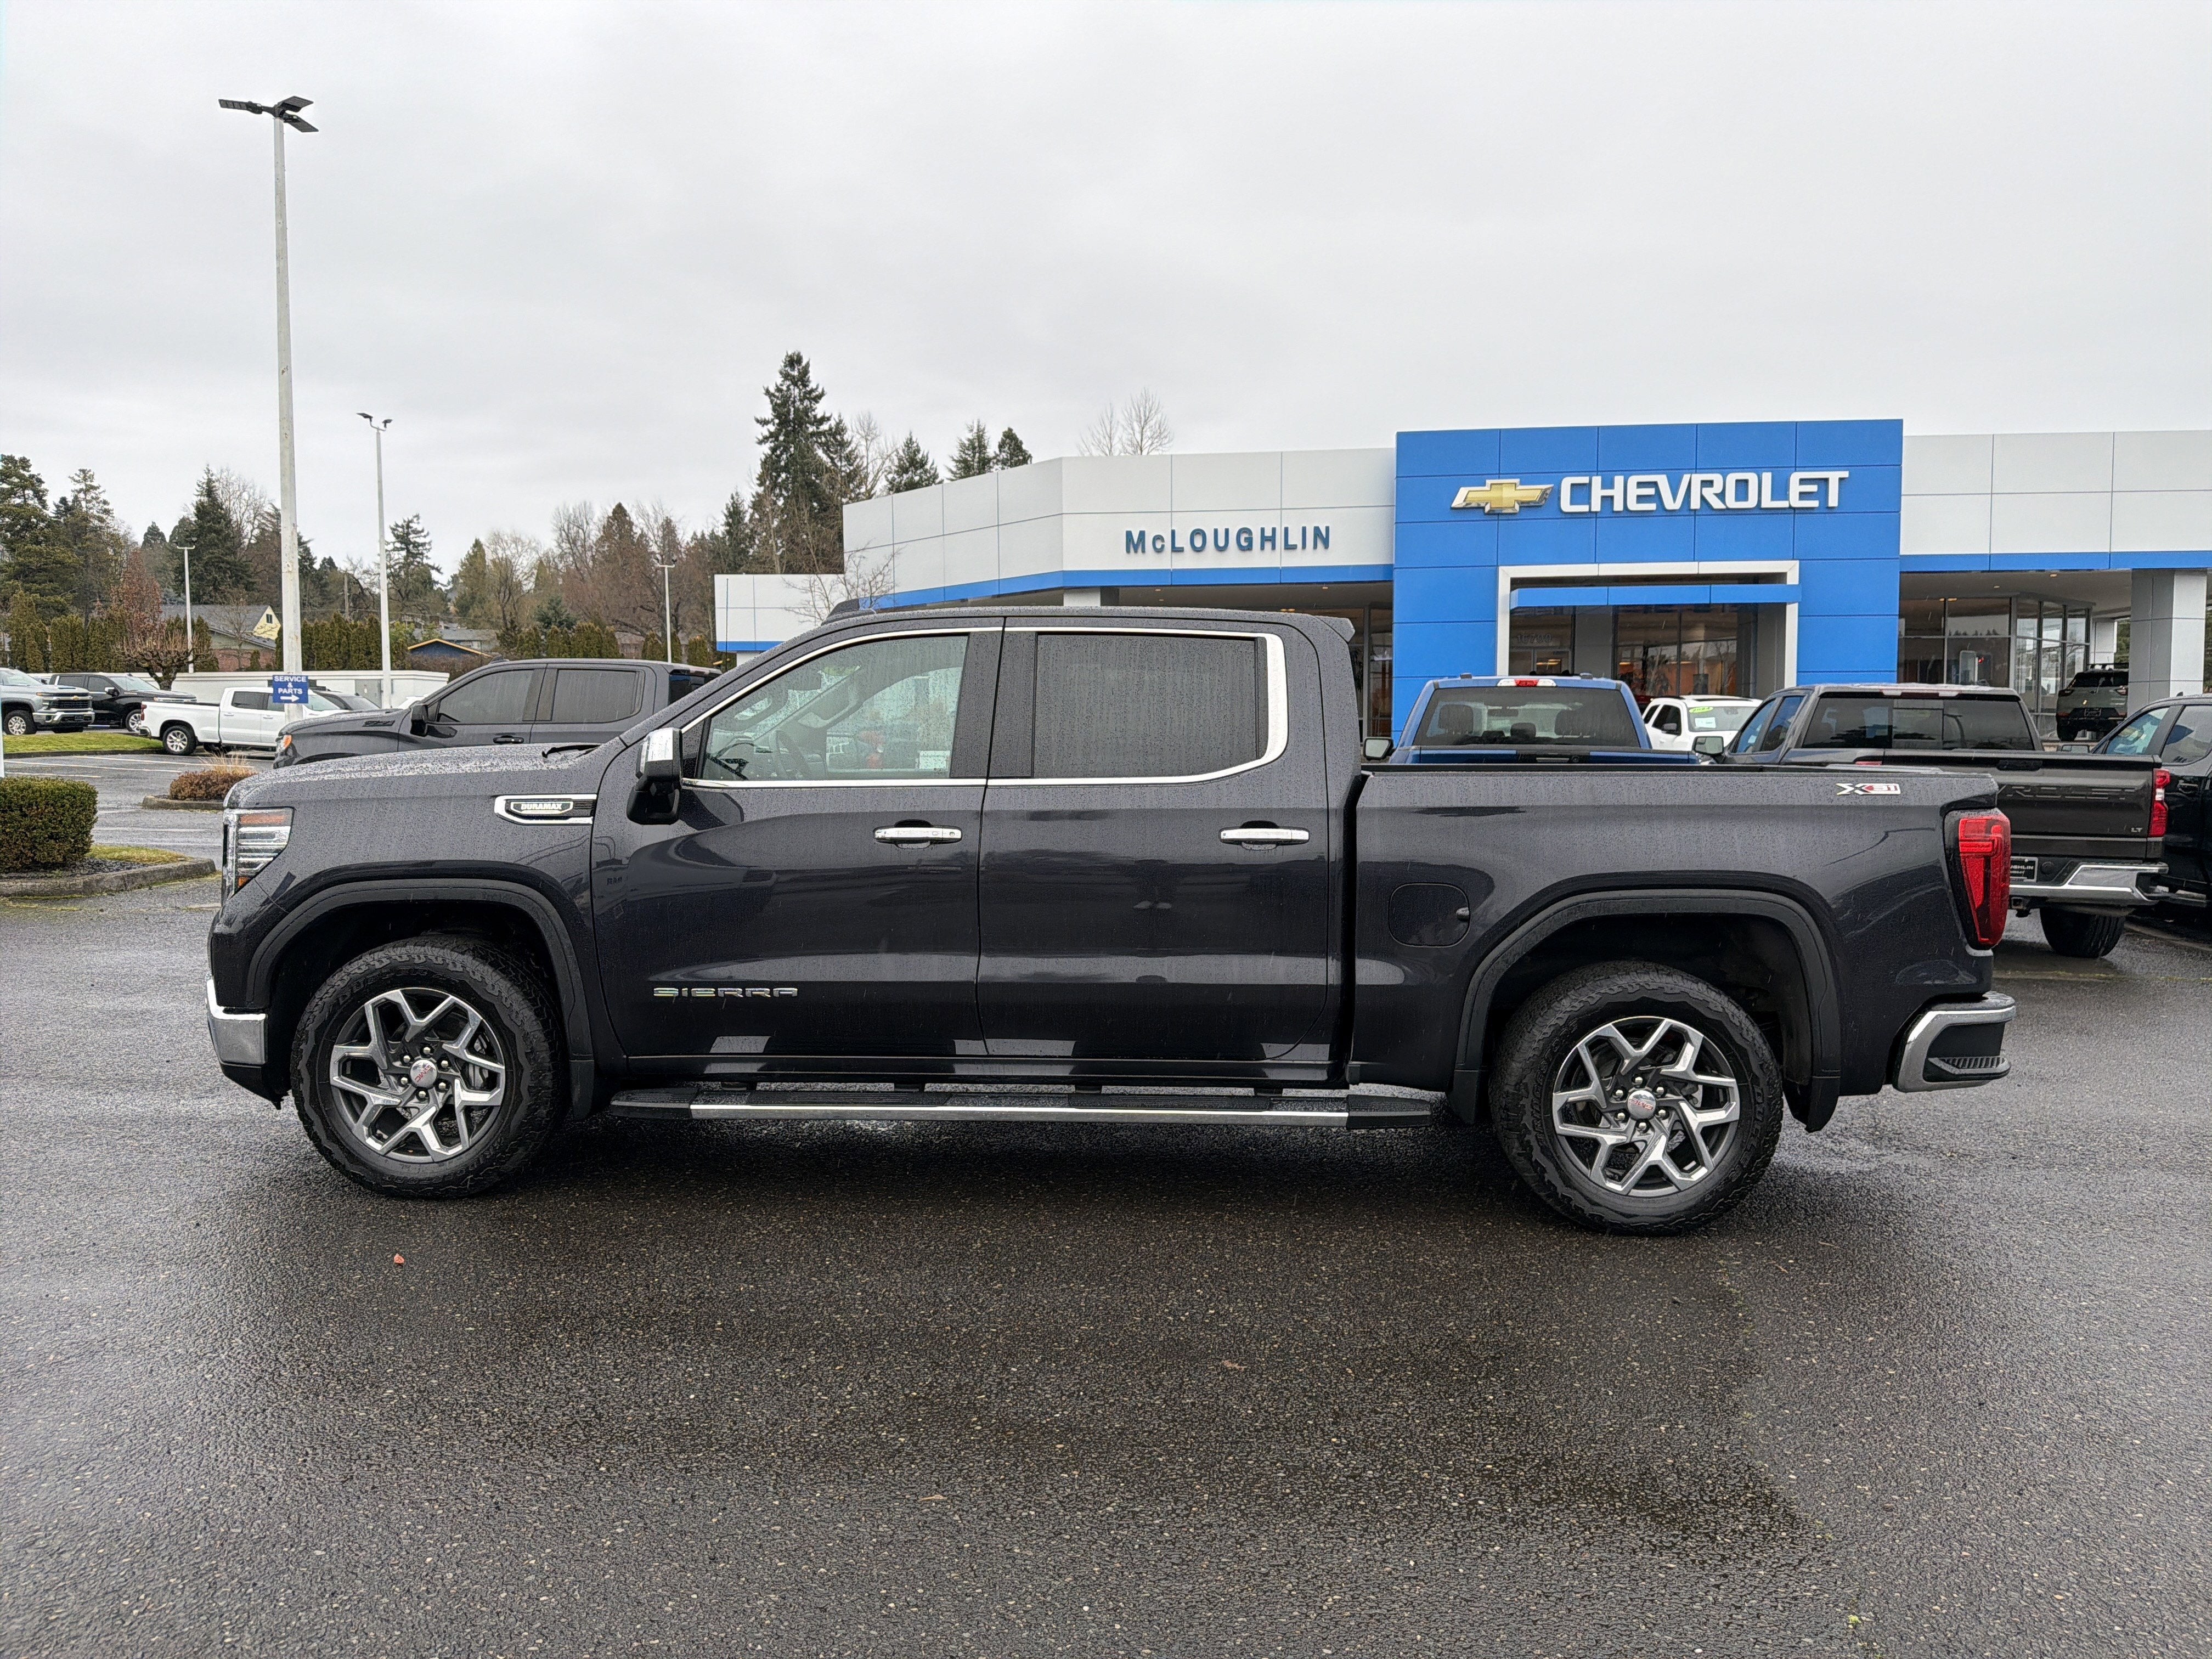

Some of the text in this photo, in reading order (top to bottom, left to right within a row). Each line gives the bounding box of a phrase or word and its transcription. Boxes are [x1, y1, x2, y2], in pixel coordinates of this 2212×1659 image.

[1561, 471, 1849, 513] CHEVROLET
[1125, 526, 1330, 554] McLOUGHLIN
[653, 988, 798, 997] SIERRA
